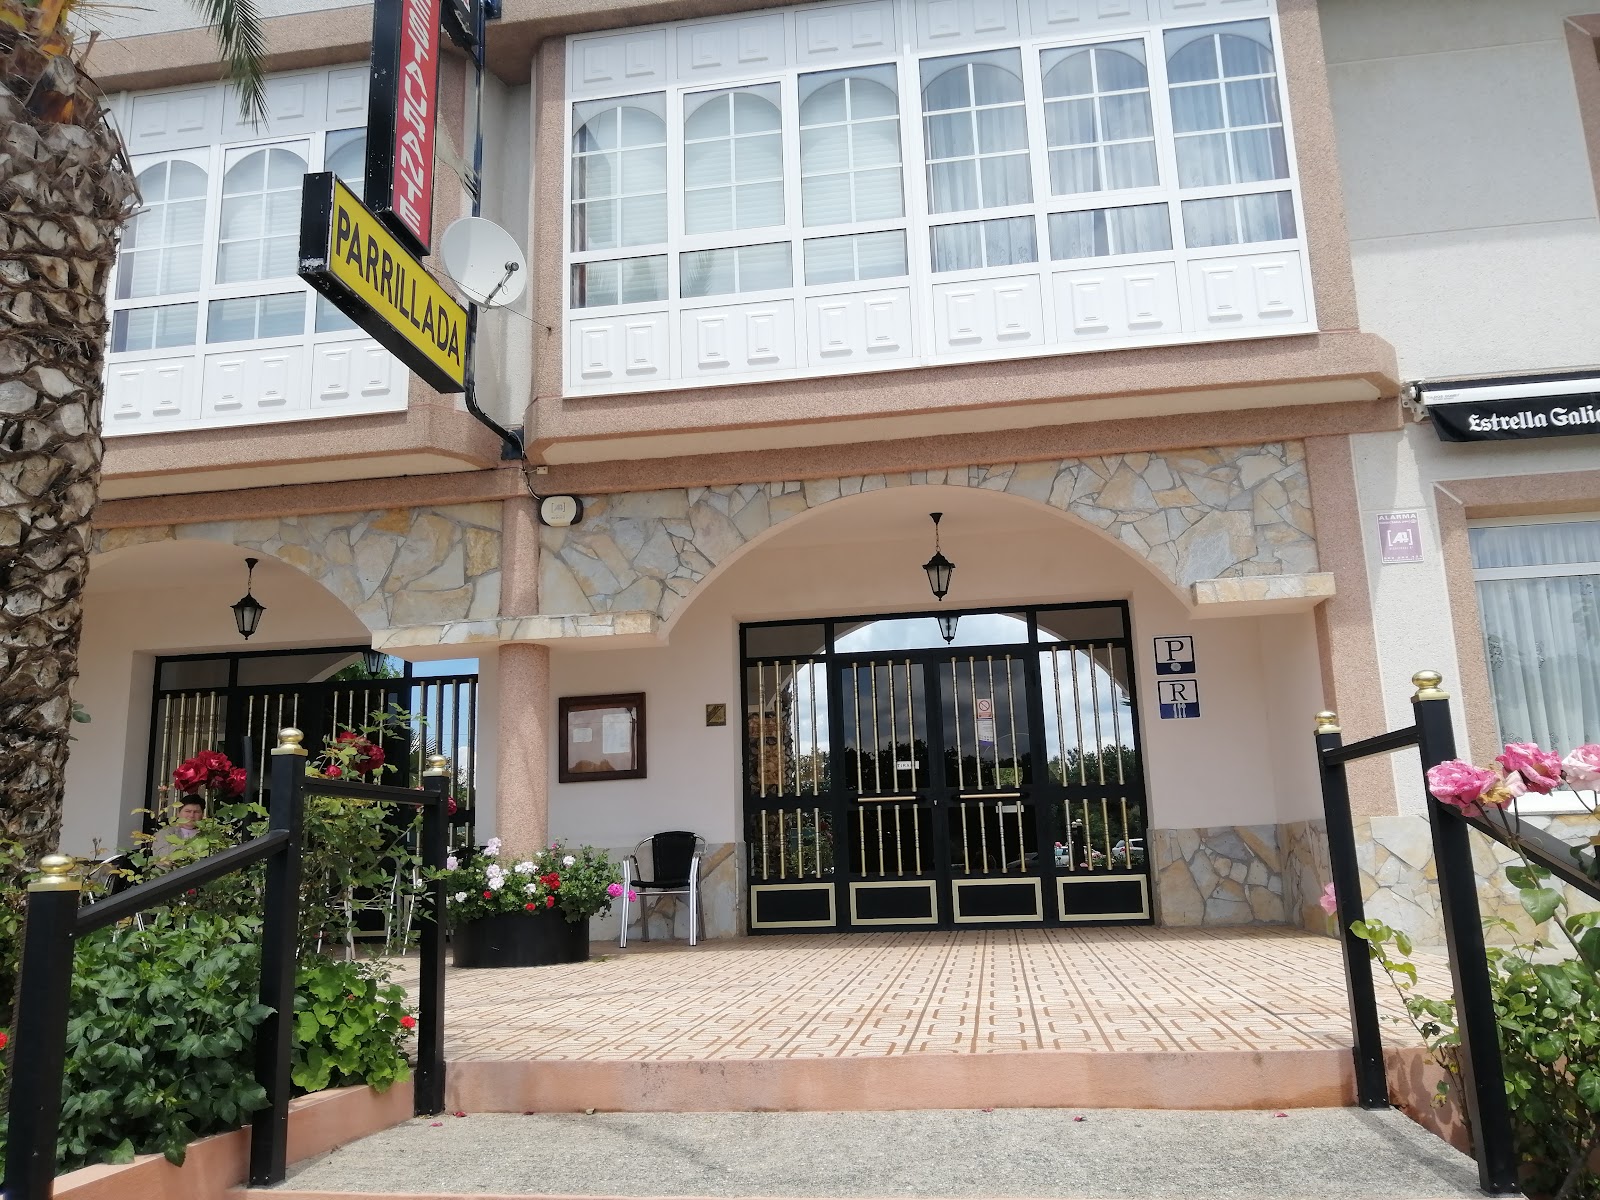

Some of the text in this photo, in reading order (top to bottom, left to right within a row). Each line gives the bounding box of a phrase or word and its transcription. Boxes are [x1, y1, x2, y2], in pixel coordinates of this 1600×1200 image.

[400, 0, 432, 235] ESTAURANTE
[336, 205, 461, 366] PARRILLADA
[1468, 411, 1549, 431] Estrella
[1378, 513, 1417, 521] ALARMA
[1165, 640, 1184, 661] P
[1170, 683, 1188, 702] R
